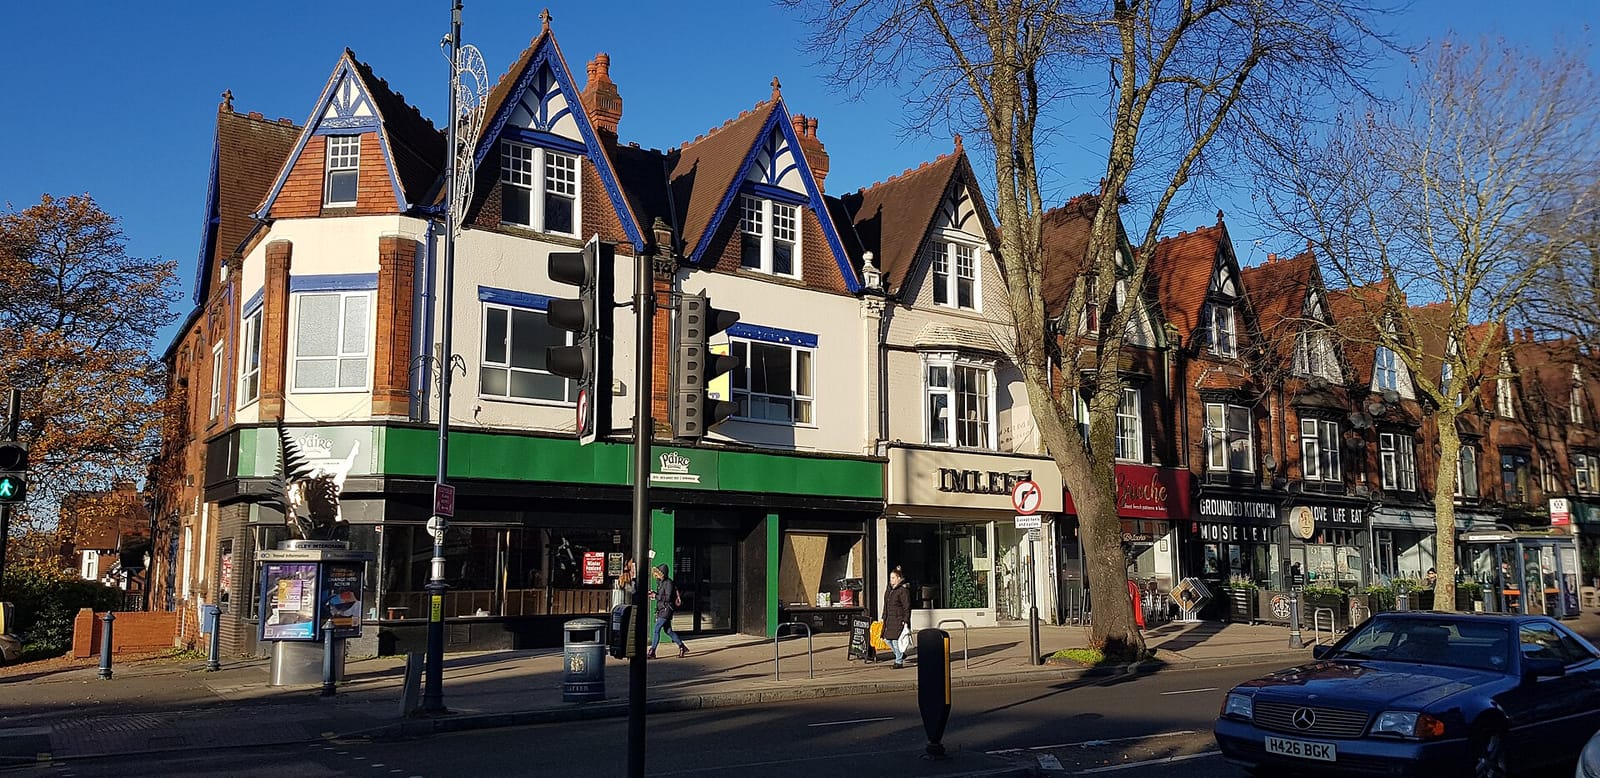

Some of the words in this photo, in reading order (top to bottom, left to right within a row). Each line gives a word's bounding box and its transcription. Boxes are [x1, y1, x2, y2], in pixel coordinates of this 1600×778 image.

[1200, 499, 1242, 516] GROUNDED
[1244, 501, 1276, 519] KITCHEN
[1351, 508, 1363, 523] EAT
[1200, 523, 1267, 542] MOSELEY
[1270, 738, 1301, 755] H426
[1303, 743, 1331, 759] BGK
